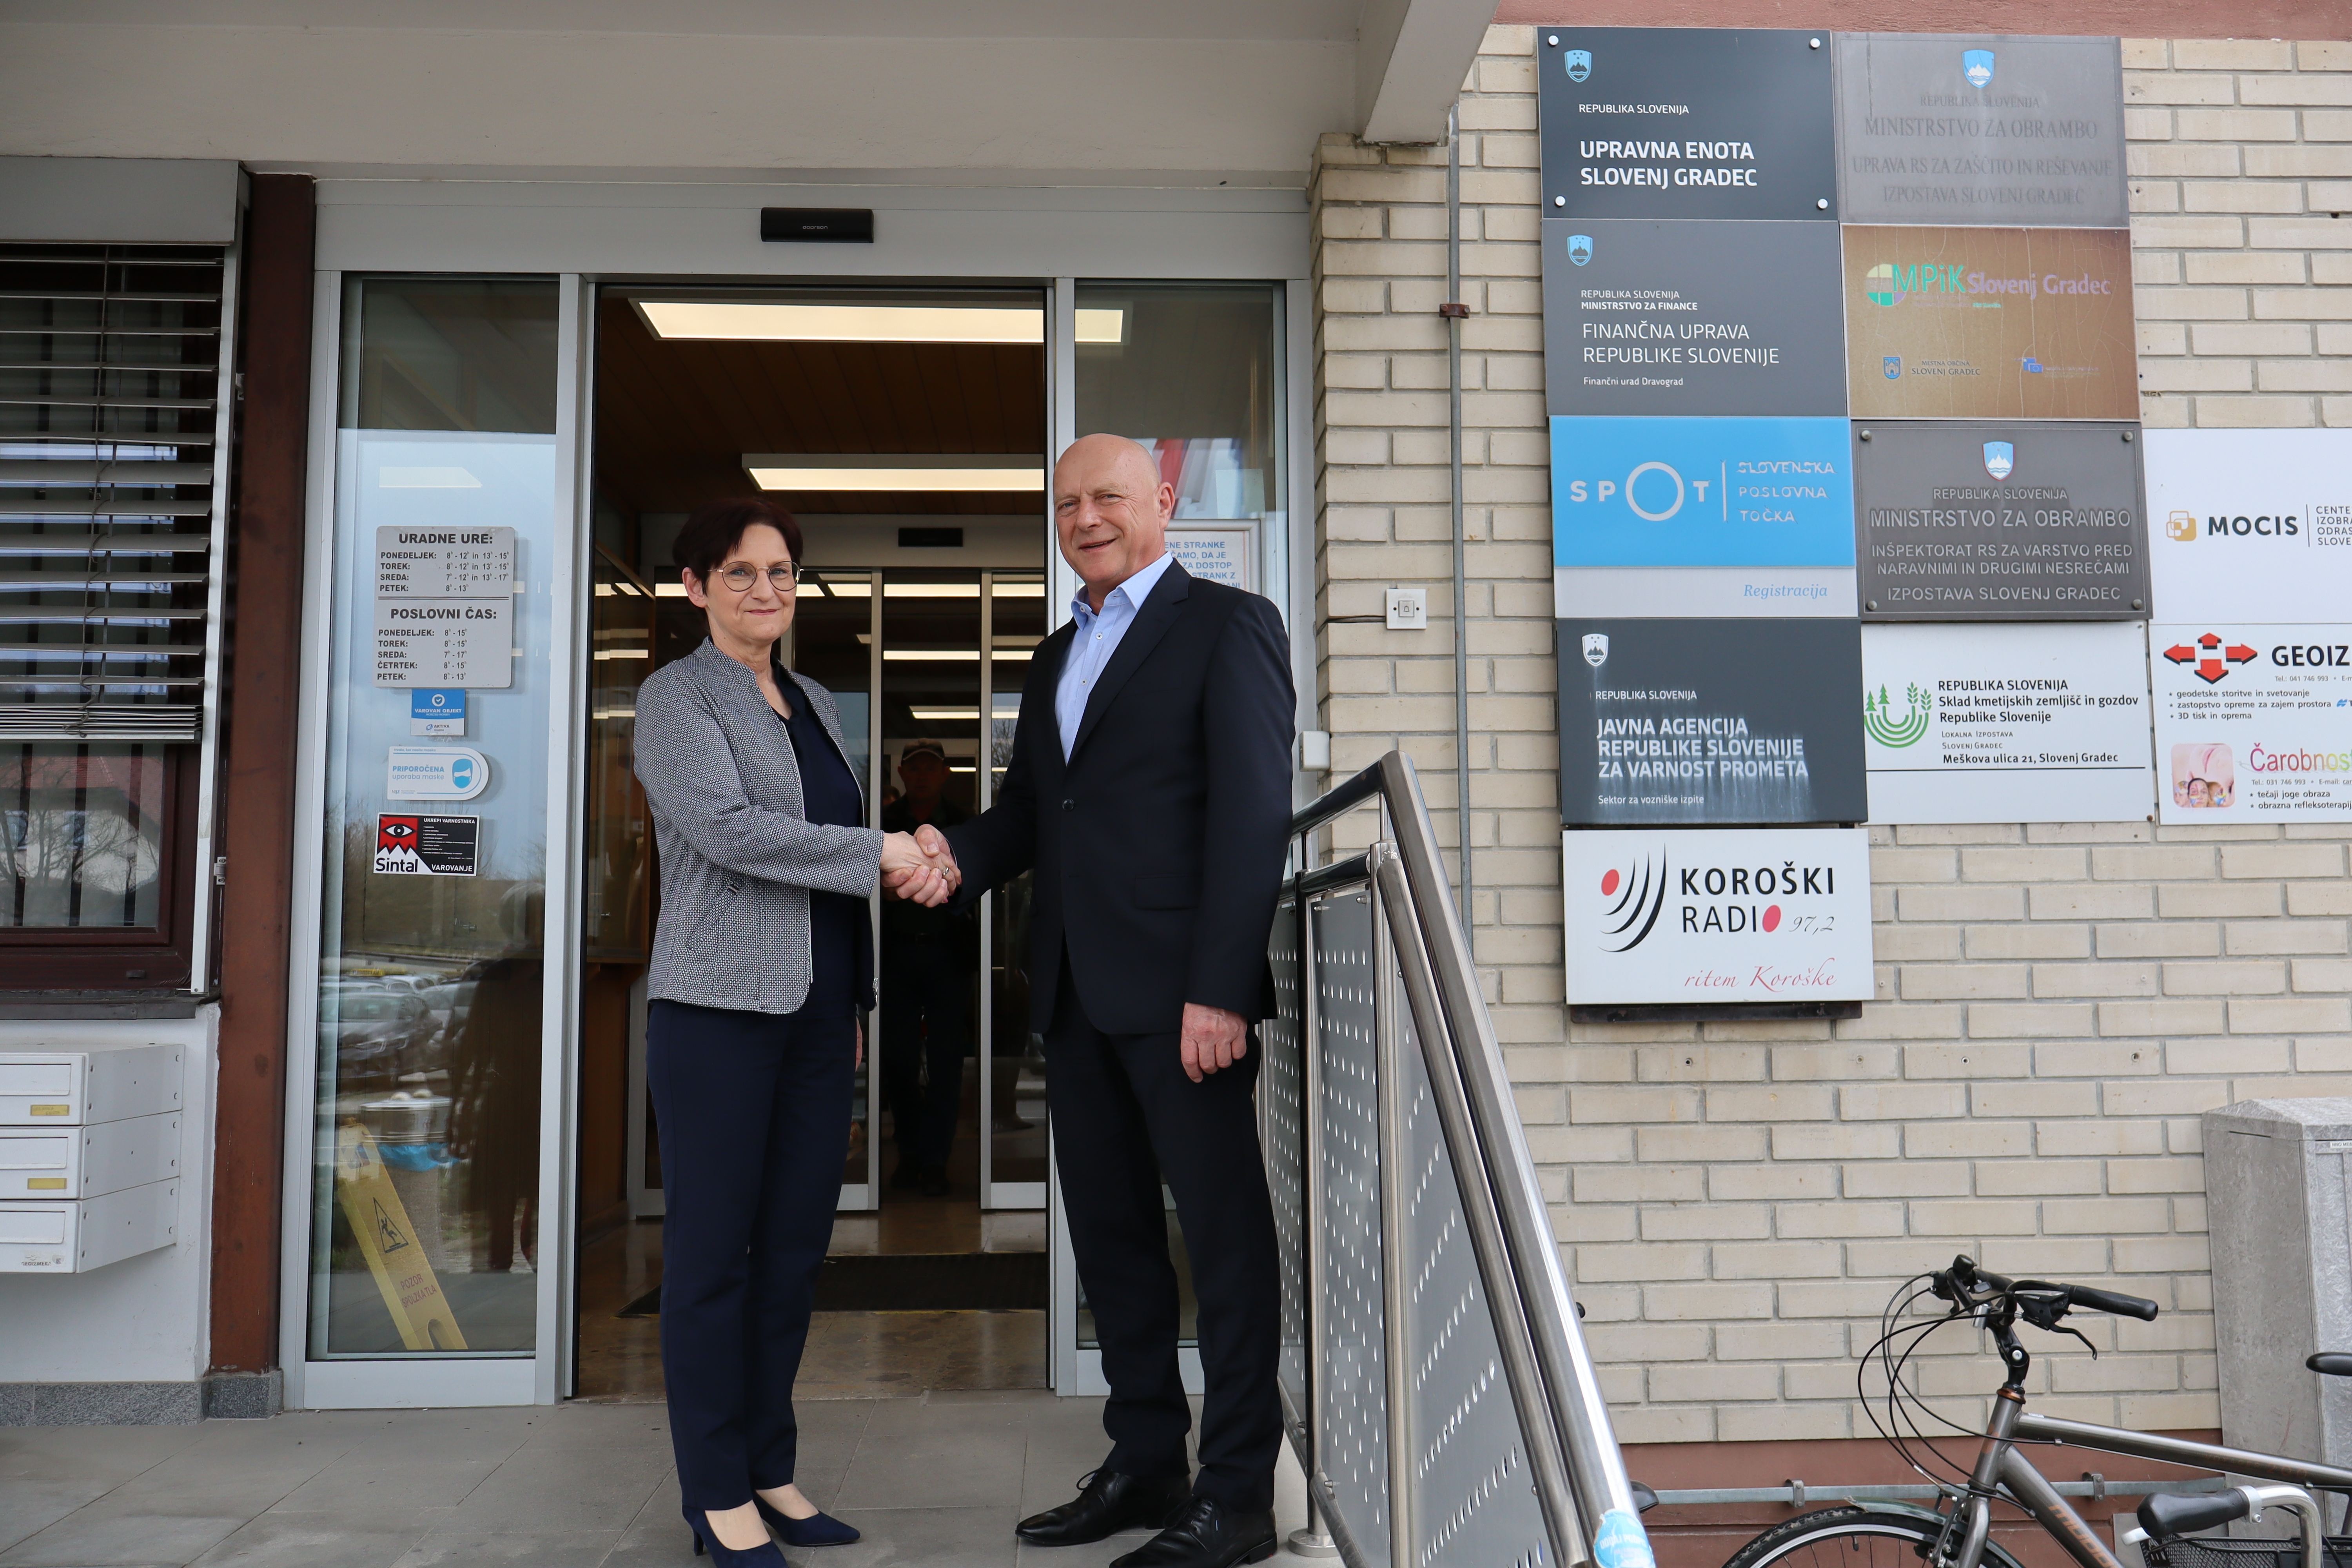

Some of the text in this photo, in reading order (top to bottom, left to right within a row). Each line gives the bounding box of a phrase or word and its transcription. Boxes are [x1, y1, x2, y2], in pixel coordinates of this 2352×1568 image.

[1579, 103, 1689, 115] REPUBLIKA SLOVENIJA
[1920, 95, 2039, 108] REPUBLIKA SLOVENIJA
[1865, 118, 2097, 139] MINISTRSTVO ZA OBRAMBO
[1580, 140, 1755, 159] UPRAVNA ENOTA
[1853, 152, 2112, 176] UPRAVA RS ZA ZAŠČITO IN REŠEVANJE
[1581, 167, 1757, 190] SLOVENJ GRADEC
[1884, 187, 2084, 204] IZPOSTAVA SLOVENJ GRADEC
[1893, 264, 2111, 299] MPiK Slovenj Gradec
[1581, 290, 1679, 299] REPUBLIKA SLOVENIJA
[1583, 321, 1749, 339] FINANČNA UPRAVA
[1584, 348, 1779, 366] REPUBLIKE SLOVENIJE
[1642, 377, 1683, 387] Dravograd
[1739, 462, 1835, 474] SLOVENSKA
[1570, 461, 1710, 521] SPOT
[1739, 486, 1827, 498] POSLOVNA
[1933, 488, 2068, 499] REPUBLIKA SLOVENIJA
[1740, 507, 1795, 522] TOČKA
[1871, 510, 2130, 527] MINISTRSTVO ZA OBRAMBO
[2209, 516, 2298, 535] MOCIS
[399, 534, 493, 544] URADNE URE:
[1872, 542, 2132, 557] INŠPEKTORAT RS ZA VARSTVO PRED
[1877, 559, 2129, 574] NARAVNIMI IN DRUGIMI NESREČAMI
[1743, 584, 1828, 599] Registracija
[1888, 588, 2120, 600] IZPOSTAVA SLOVENJ GRADEC
[391, 607, 497, 619] POSLOVNI ČAS:
[2272, 646, 2350, 666] GEOIZ
[377, 661, 417, 669] ČETRTEK:
[1938, 680, 2068, 692] REPUBLIKA SLOVENIJA
[1596, 690, 1697, 701] REPUBLIKA SLOVENIJA
[1939, 695, 2138, 709] Sklad kmetijskih zemljišč in gozdov
[2177, 690, 2218, 699] geodetske
[2267, 690, 2309, 698] svetovanje
[2178, 702, 2221, 710] zastopstvo
[2271, 701, 2294, 709] zajem
[1940, 711, 2051, 723] Republike Slovenije
[1597, 718, 1748, 739] JAVNA AGENCIJA
[1598, 739, 1803, 759] REPUBLIKE SLOVENIJE
[1943, 752, 2118, 765] Meškova ulica 21, Slovenj Gradec
[1599, 760, 1809, 778] ZA VARNOST PROMETA
[1599, 795, 1626, 804] Sektor
[1641, 795, 1678, 804] vozniške
[1681, 794, 1704, 806] izpite
[2258, 790, 2278, 799] tečaji
[2282, 791, 2299, 799] joge
[2295, 801, 2352, 810] refleksoterapij
[376, 857, 418, 872] Sintal
[1681, 861, 1834, 895] KOROŠKI
[1684, 957, 1837, 993] ritem Koroške
[400, 1274, 424, 1290] POZOR
[402, 1285, 437, 1308] SPOLZKA TLA
